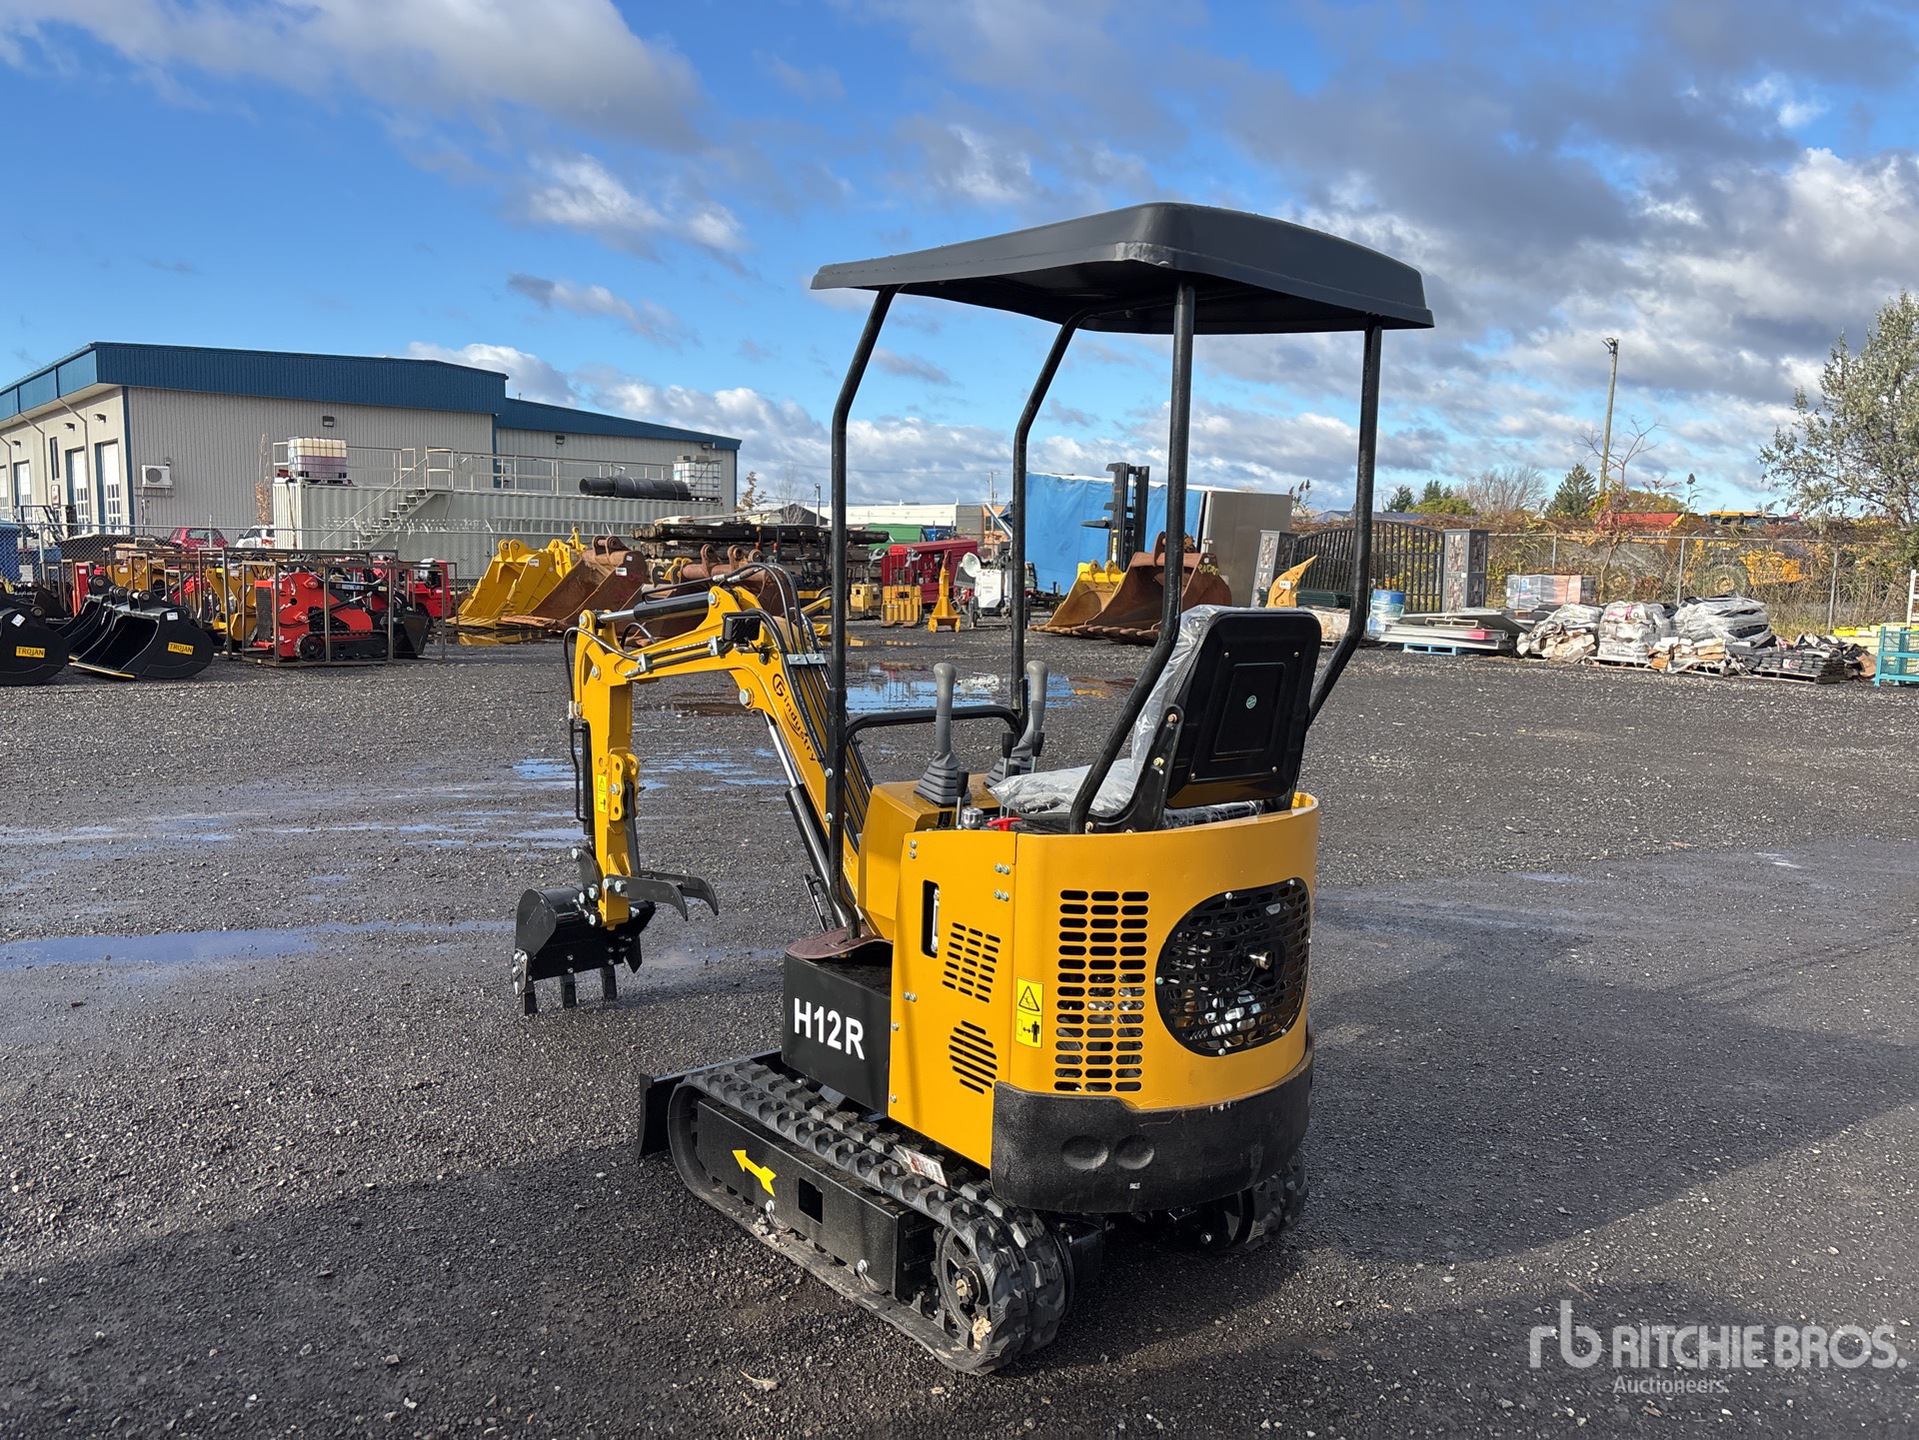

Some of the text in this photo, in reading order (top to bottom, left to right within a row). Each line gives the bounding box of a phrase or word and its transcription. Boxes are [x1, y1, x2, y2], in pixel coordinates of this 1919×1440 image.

[17, 647, 44, 657] TROJAN
[169, 644, 193, 653] TROJAN
[794, 997, 865, 1060] H12R
